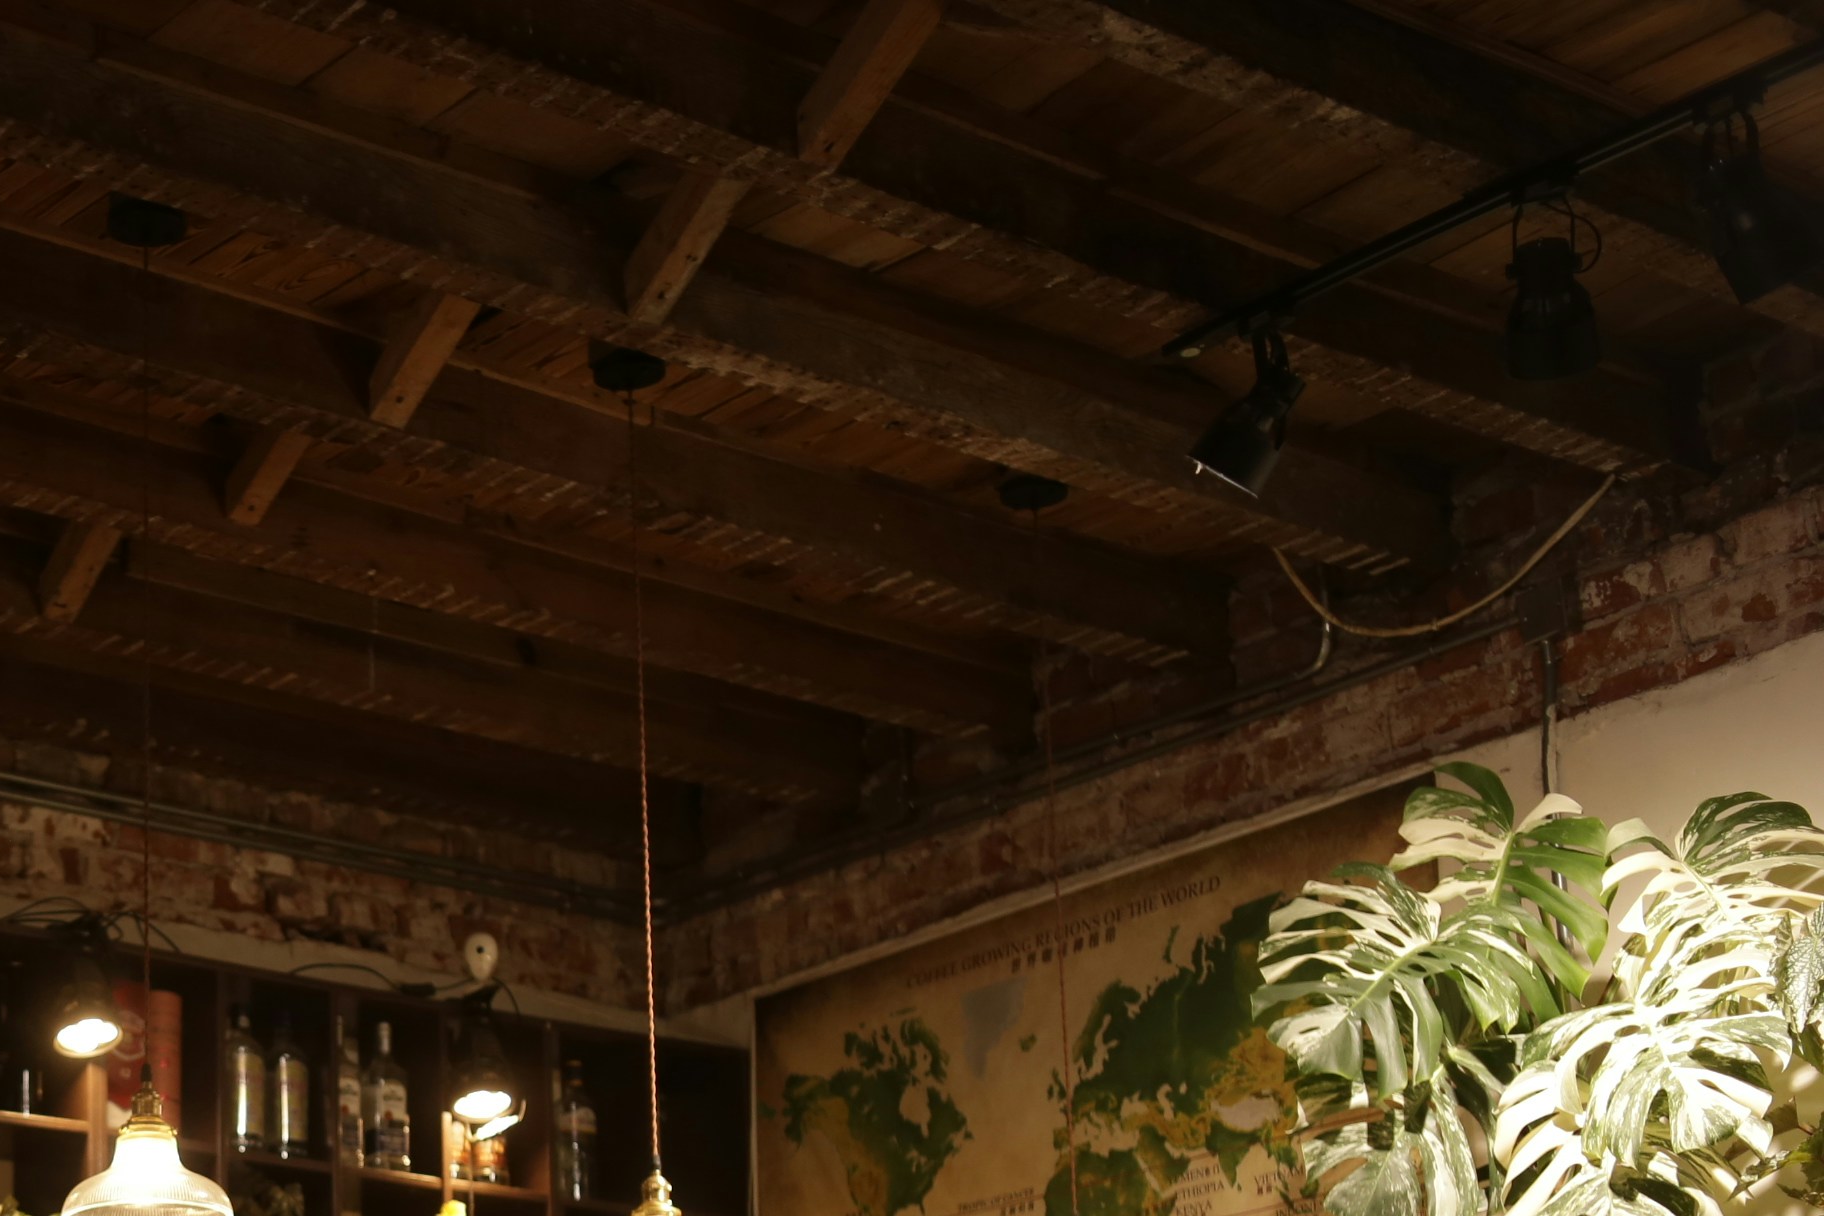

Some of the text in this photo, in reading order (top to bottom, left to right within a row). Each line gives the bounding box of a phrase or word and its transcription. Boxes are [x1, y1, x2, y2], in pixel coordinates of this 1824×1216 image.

[961, 940, 1033, 970] GROWING
[1103, 906, 1121, 926] OF
[1129, 897, 1158, 918] THE
[1160, 875, 1221, 908] WORLD
